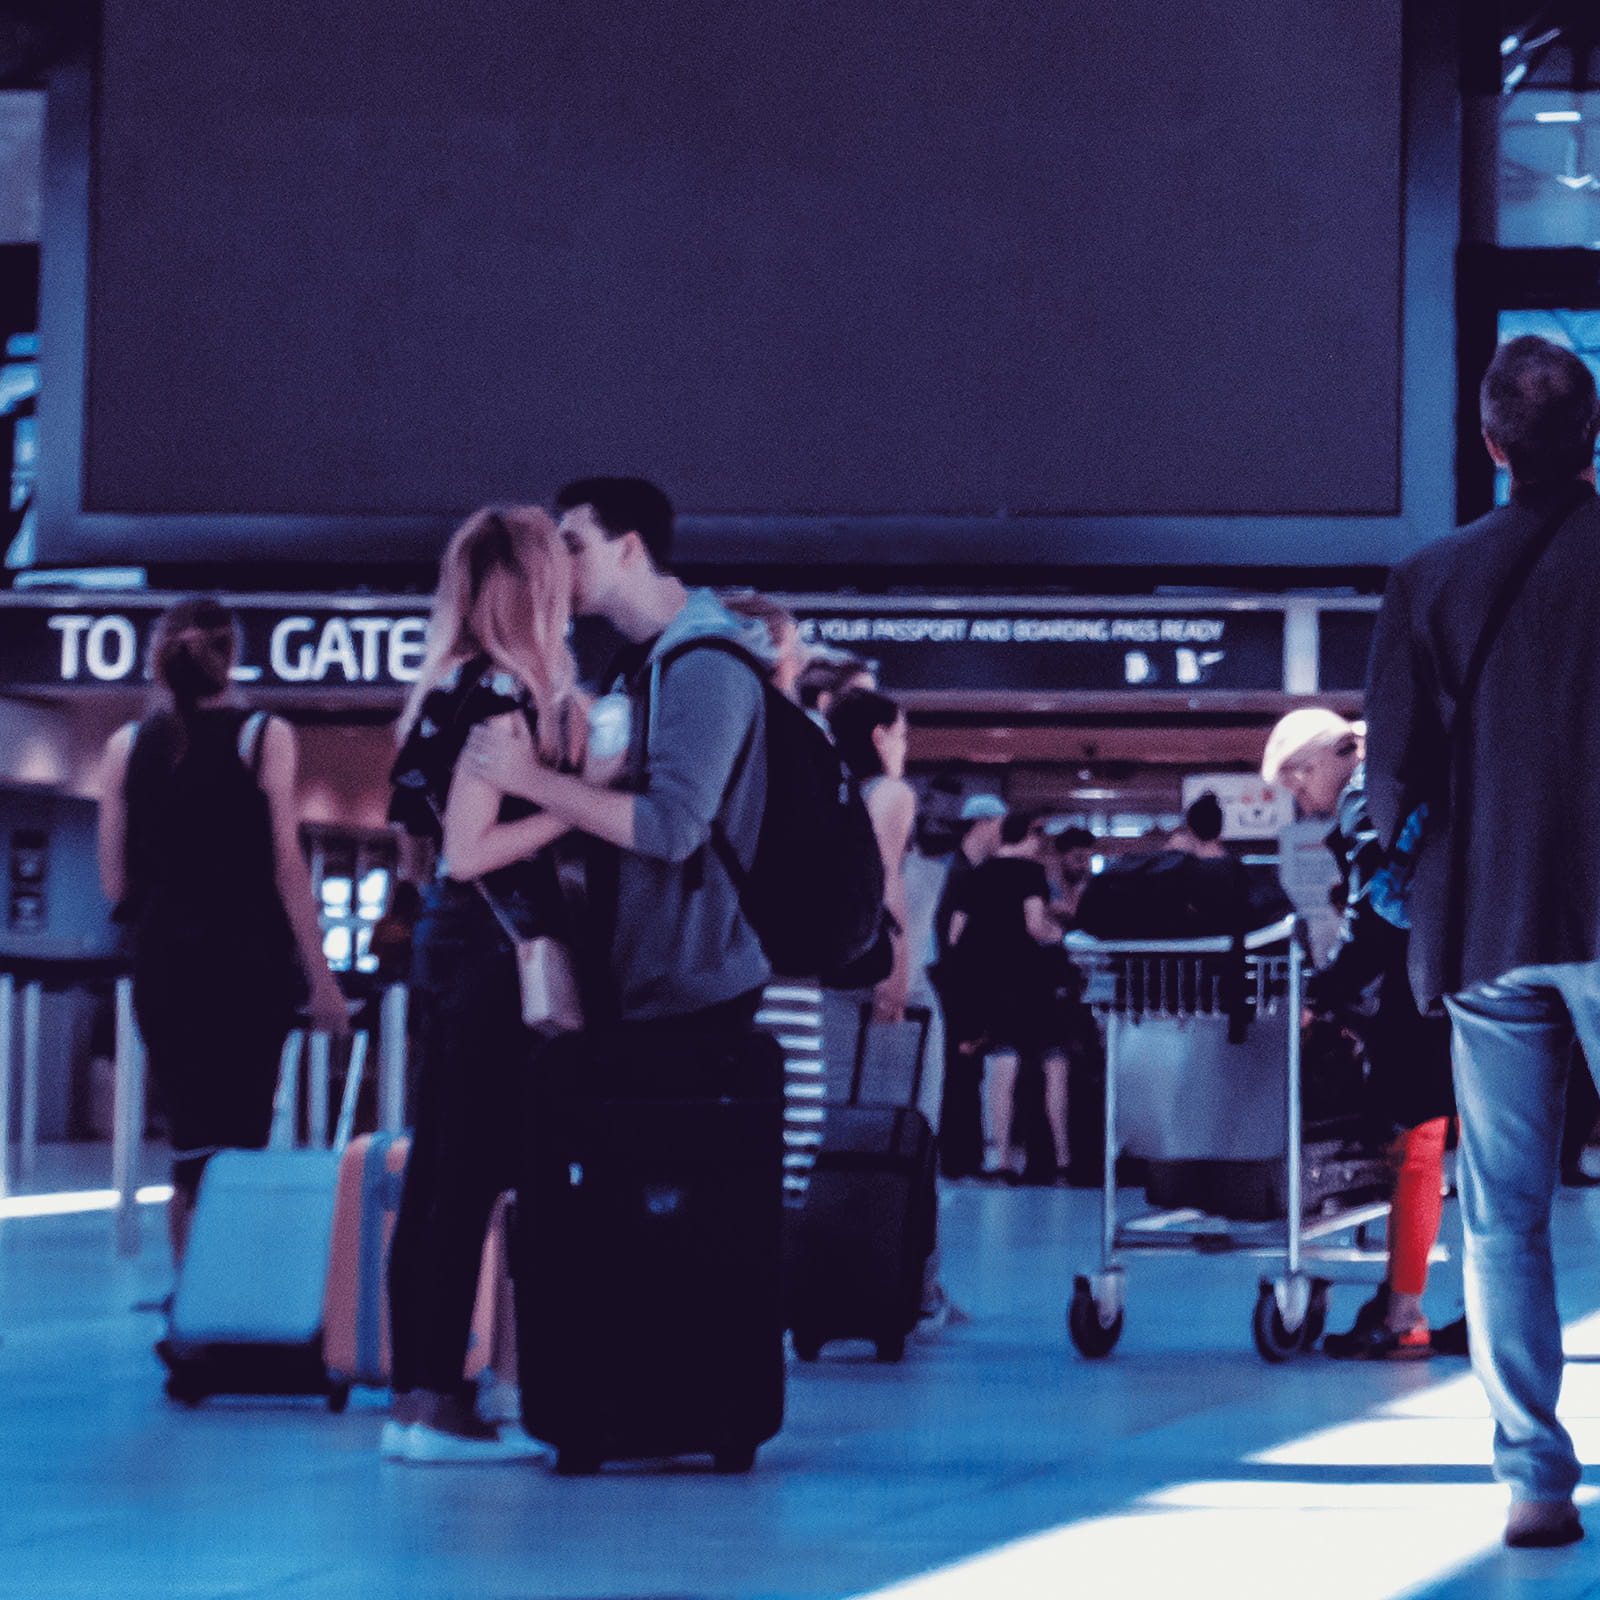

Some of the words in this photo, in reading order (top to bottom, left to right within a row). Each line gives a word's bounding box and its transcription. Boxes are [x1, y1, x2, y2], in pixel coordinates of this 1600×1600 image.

[48, 613, 136, 682] TO
[873, 618, 968, 642] PASSPORT
[969, 618, 1012, 642] AND
[1013, 618, 1109, 642] BOARDING
[1160, 618, 1226, 642] READY
